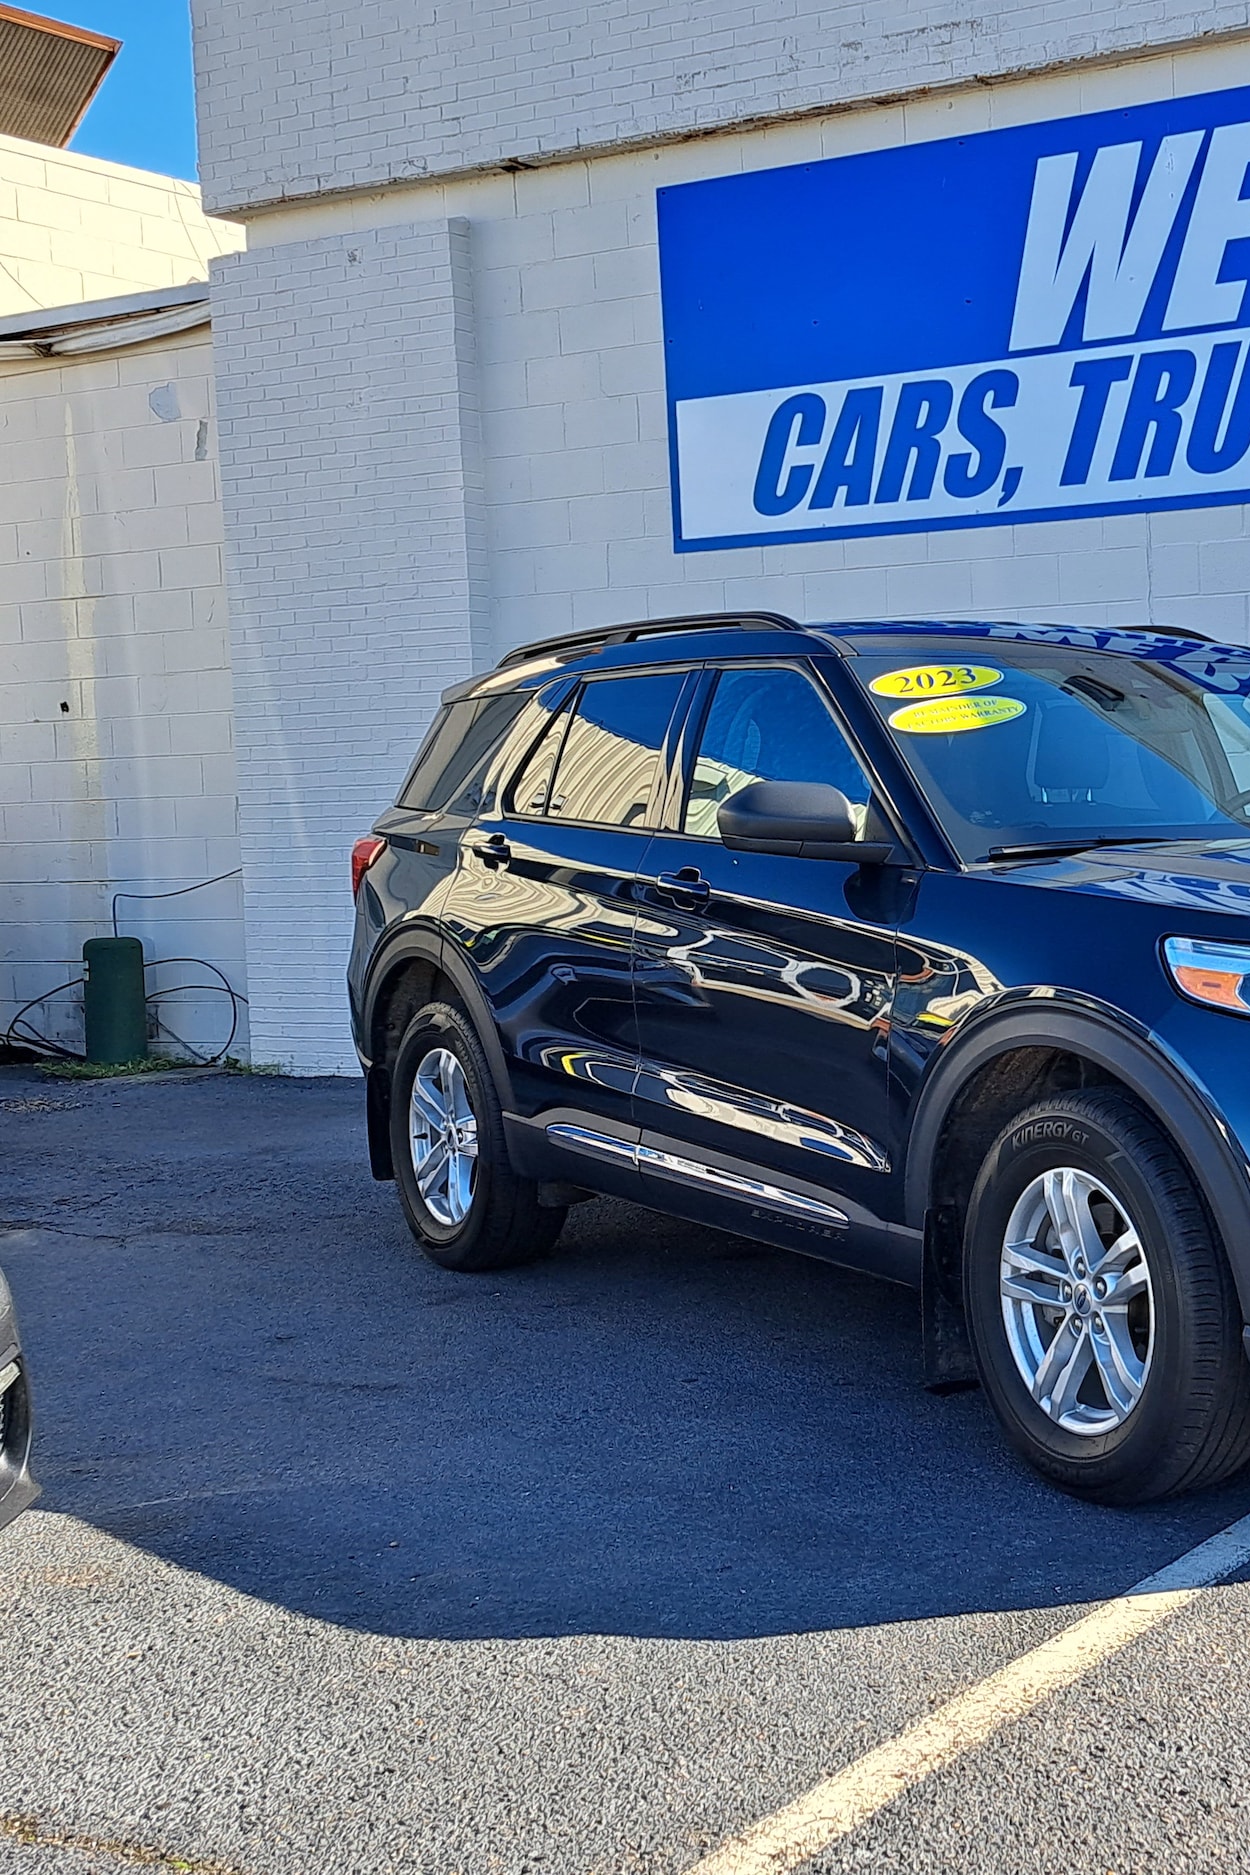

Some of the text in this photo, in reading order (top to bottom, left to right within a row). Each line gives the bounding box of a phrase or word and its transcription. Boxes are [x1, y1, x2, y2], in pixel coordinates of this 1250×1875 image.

[752, 367, 1024, 517] CARS,
[894, 667, 977, 693] 2023
[960, 706, 1019, 719] WARRANTY
[983, 699, 998, 707] OF
[1011, 1121, 1090, 1151] KINERGY GT
